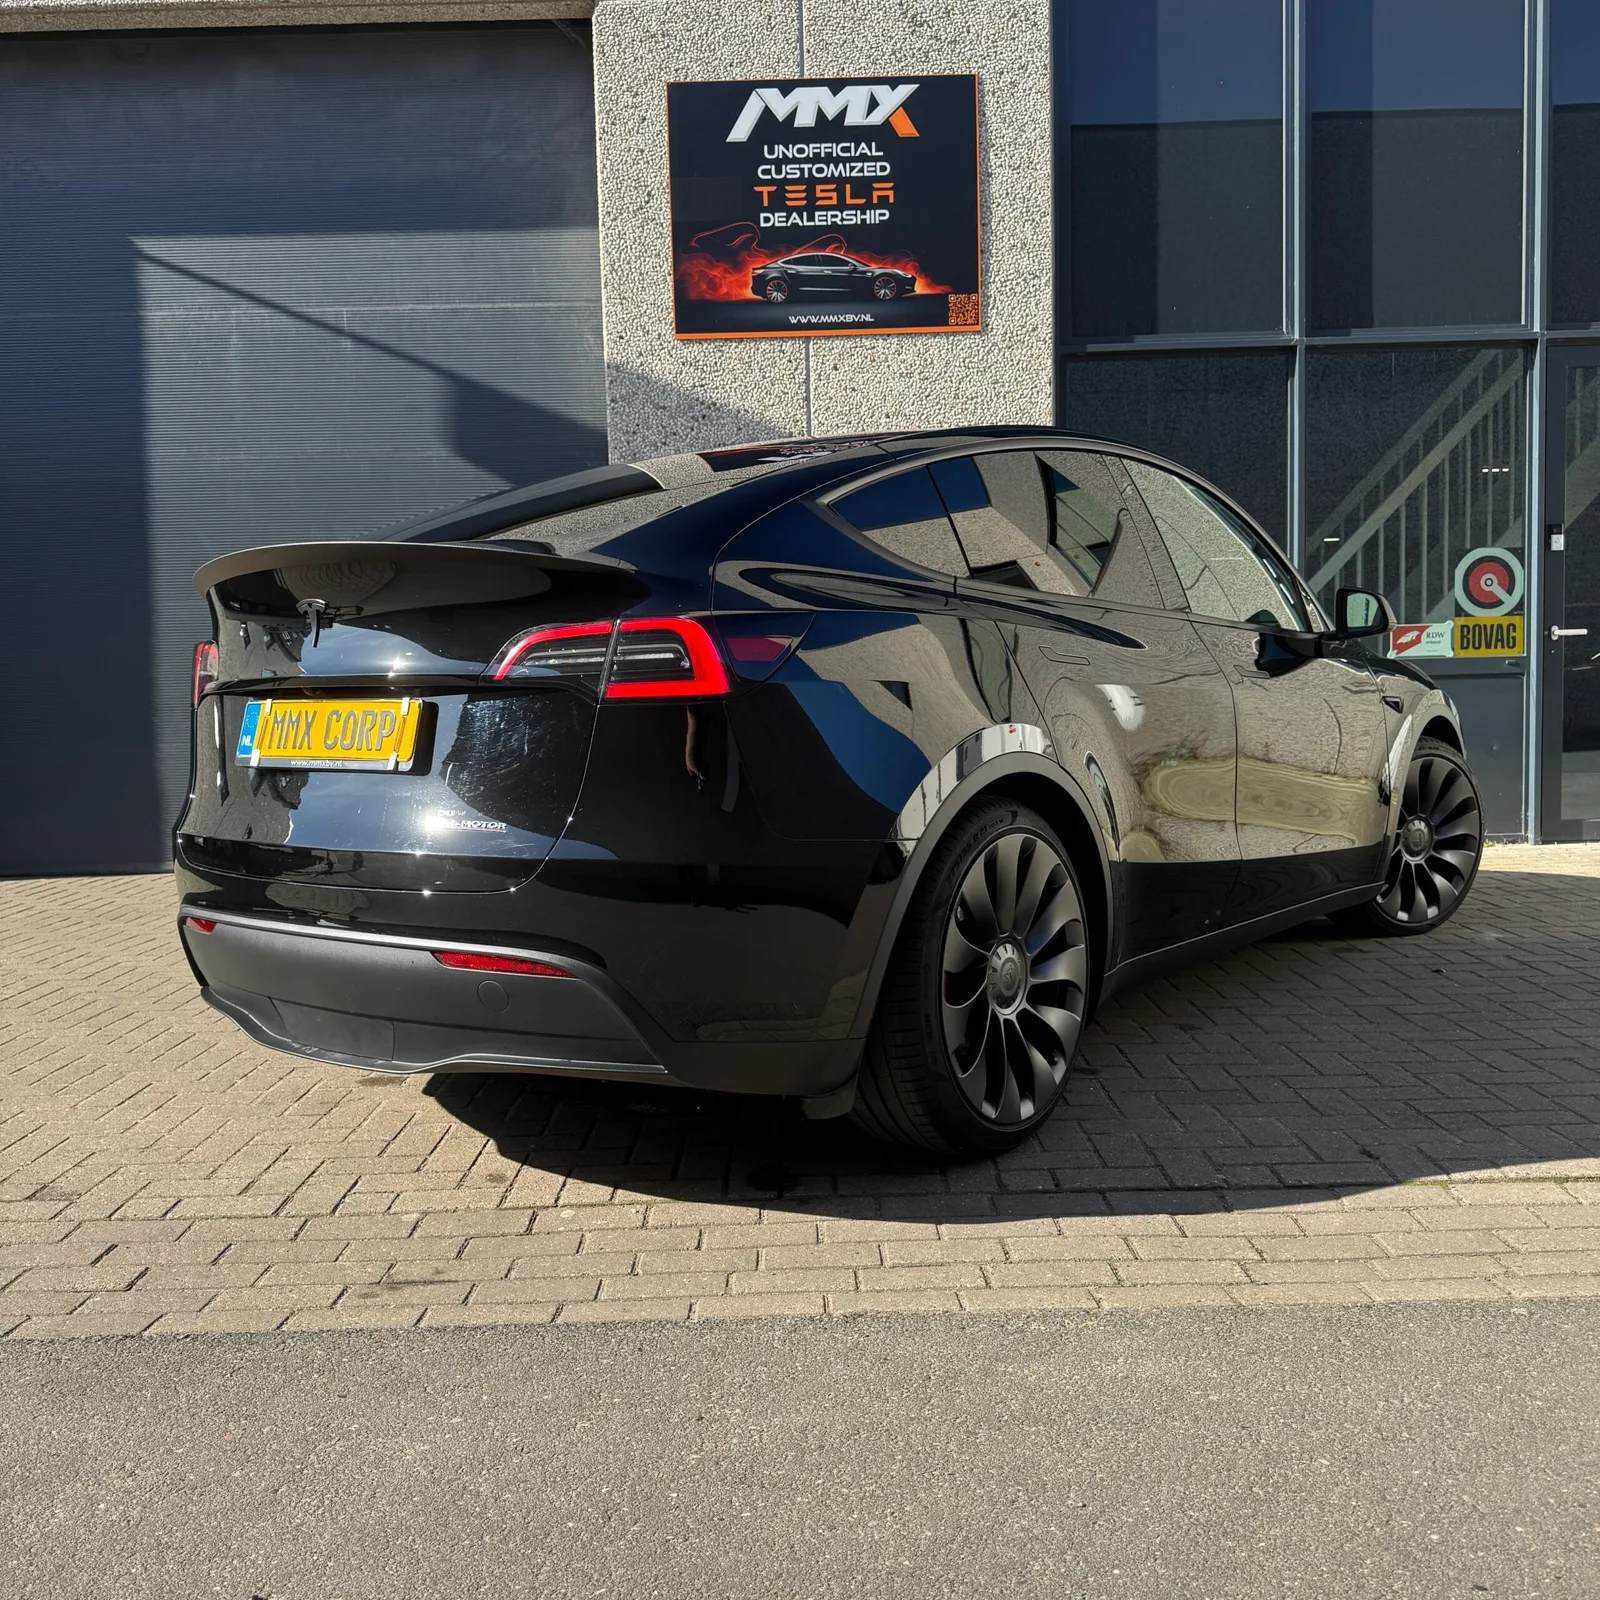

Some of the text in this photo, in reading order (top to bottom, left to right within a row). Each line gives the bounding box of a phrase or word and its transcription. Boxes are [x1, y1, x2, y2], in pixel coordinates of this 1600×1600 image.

[725, 84, 921, 143] MMX
[763, 141, 884, 160] UNOFFICIAL
[757, 161, 891, 180] CUSTOMIZED
[753, 182, 894, 207] TESLA
[759, 209, 890, 228] DEALERSHIP
[788, 314, 875, 324] WWW.MMXBV.NL
[1426, 631, 1446, 639] RDW
[1460, 623, 1516, 650] BOVAG
[267, 709, 397, 751] MMX CORP
[241, 735, 253, 747] NL
[290, 759, 344, 768] www.mmxbv.nl
[460, 820, 507, 830] MOTOR
[973, 825, 987, 842] R21
